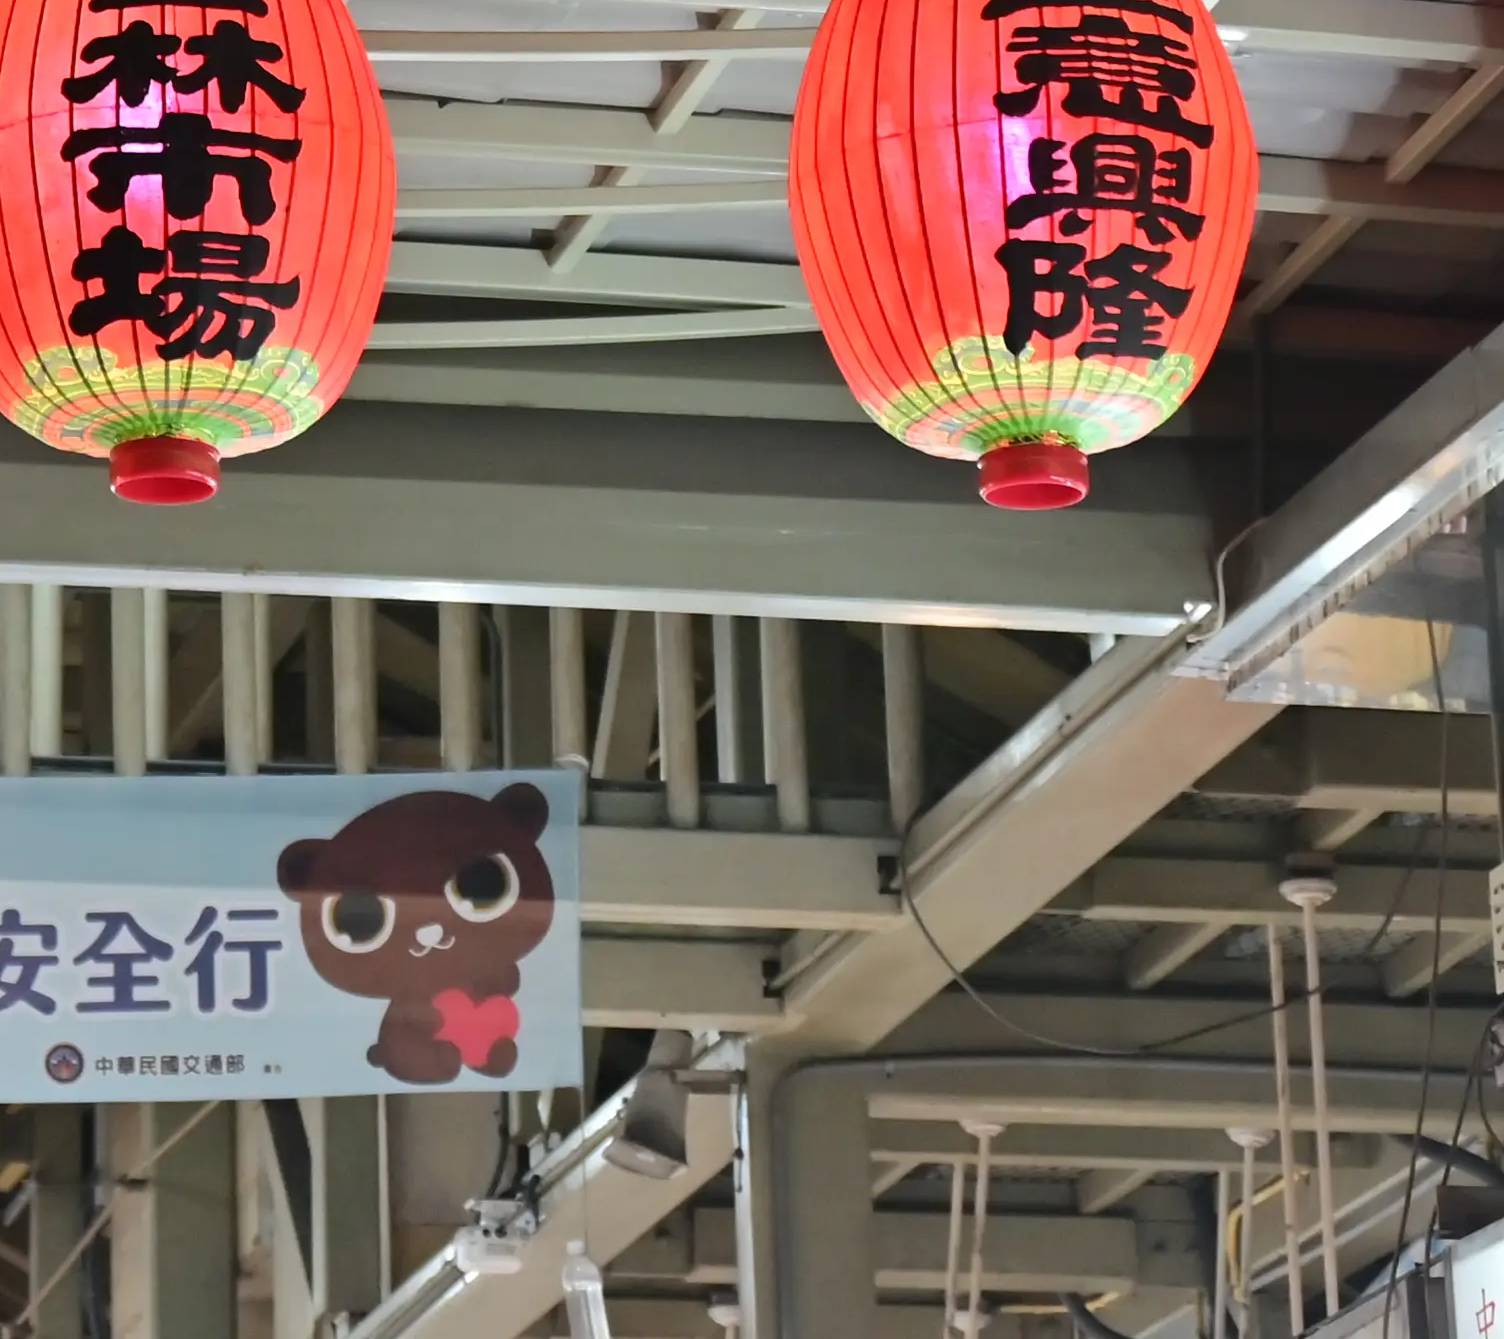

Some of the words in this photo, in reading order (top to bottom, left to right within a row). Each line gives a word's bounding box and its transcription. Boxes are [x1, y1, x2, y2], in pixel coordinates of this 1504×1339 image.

[95, 1054, 244, 1077] 中華民國交通部
